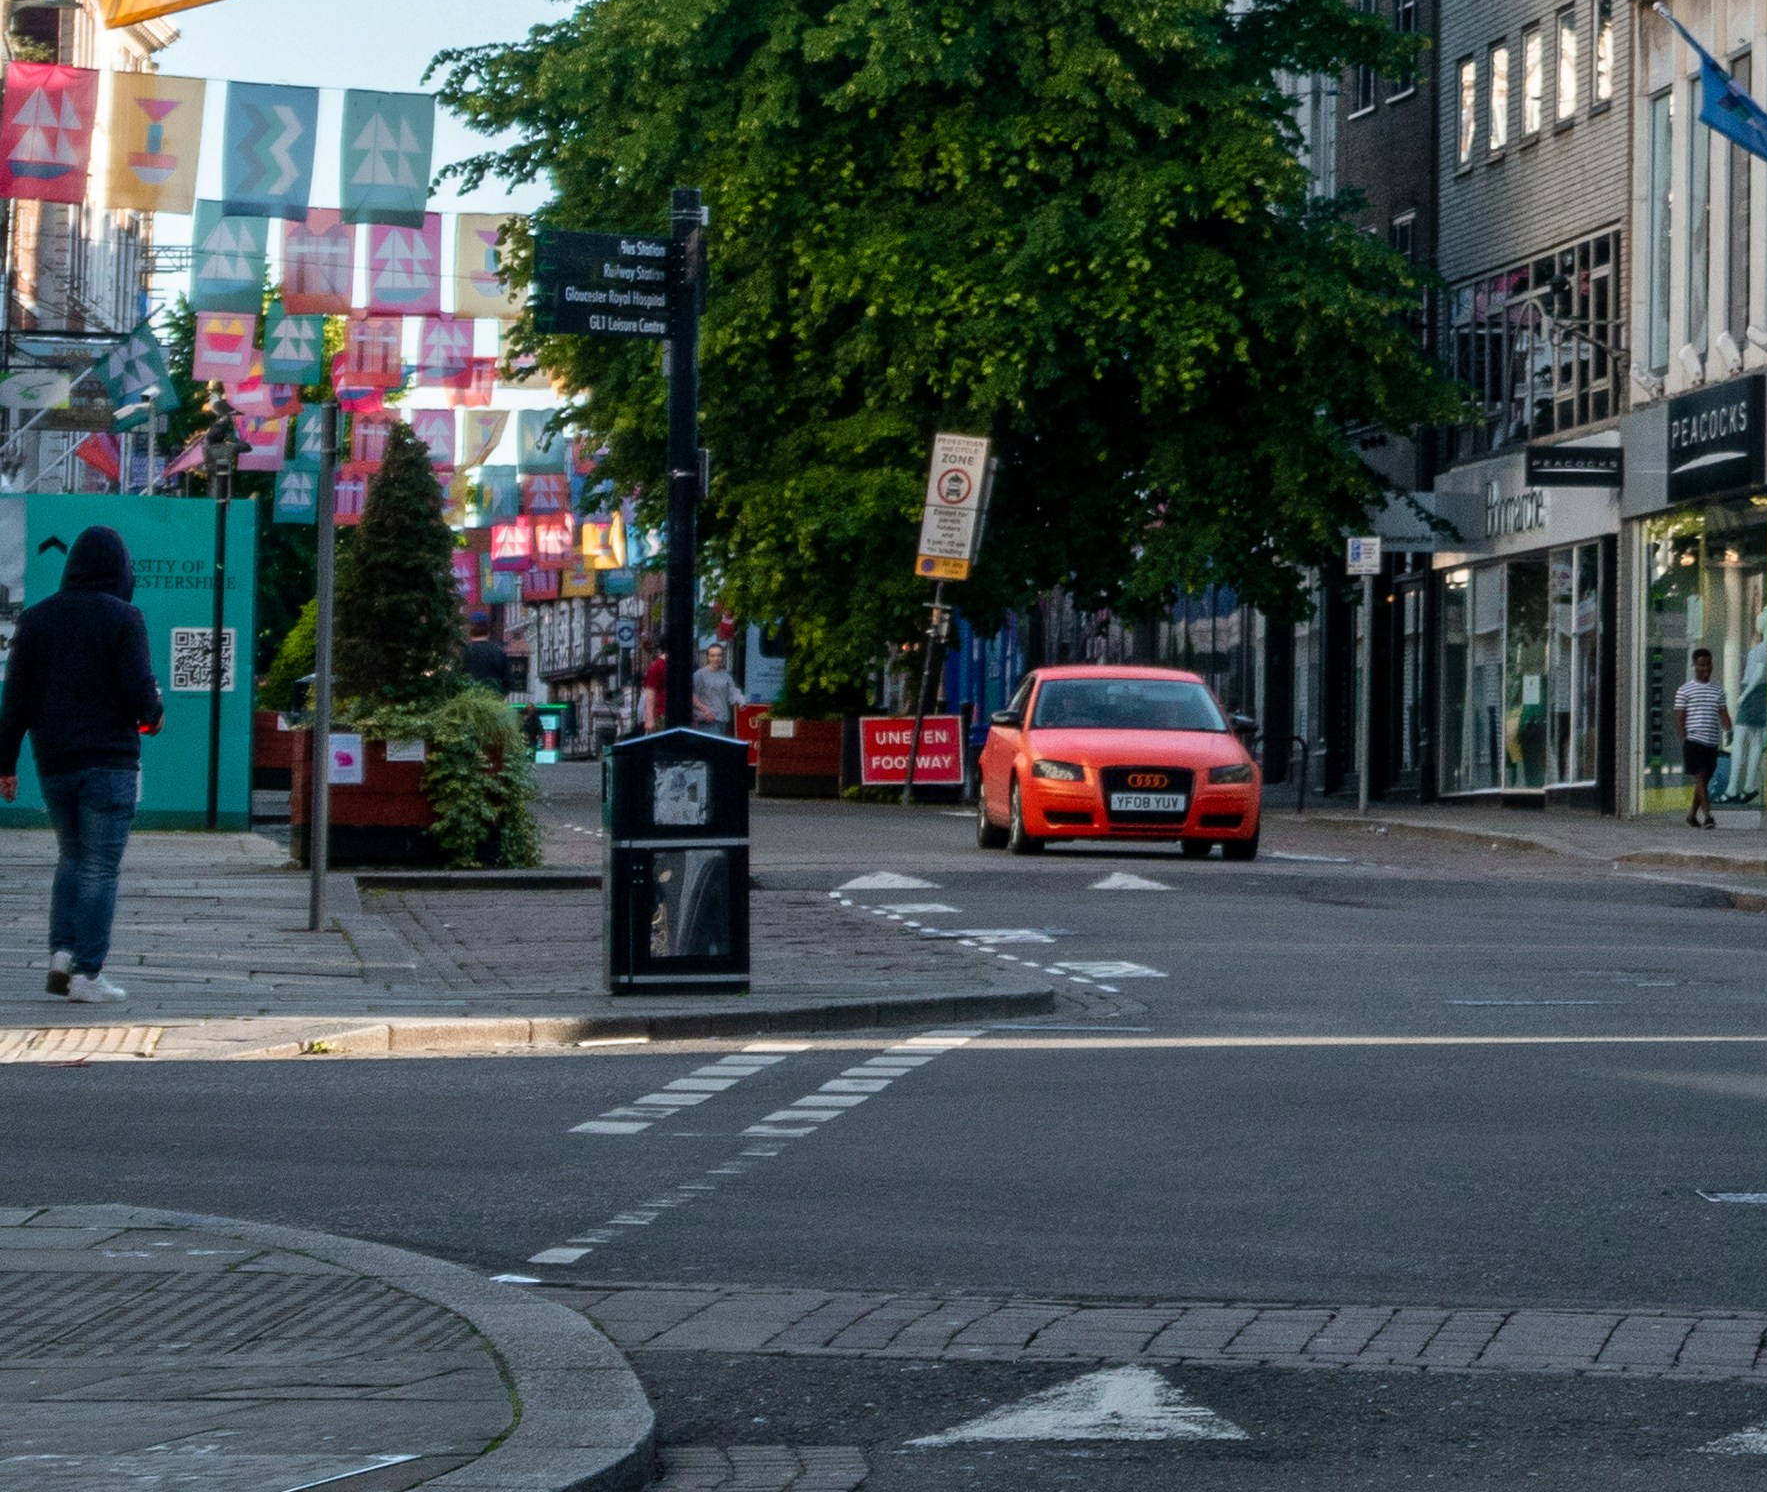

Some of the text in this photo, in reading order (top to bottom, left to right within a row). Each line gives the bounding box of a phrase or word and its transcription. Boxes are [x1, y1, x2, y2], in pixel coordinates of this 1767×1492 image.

[620, 240, 666, 257] Bus Station
[603, 263, 665, 282] Railway Station
[565, 286, 666, 308] Gloucester Royal Hospital
[608, 316, 637, 332] Leisure
[639, 318, 666, 334] Centre
[1671, 401, 1748, 449] PEACOCKS
[937, 437, 984, 448] PEDESTRIAN
[955, 446, 979, 454] CYCLE
[941, 453, 975, 466] ZONE
[1531, 459, 1618, 469] PEACOCKS
[131, 559, 205, 574] RSITY OF
[133, 575, 236, 589] ESTERSHIE
[875, 730, 947, 745] UNEEN
[872, 756, 952, 770] FOOWAY
[1117, 796, 1151, 809] YF08
